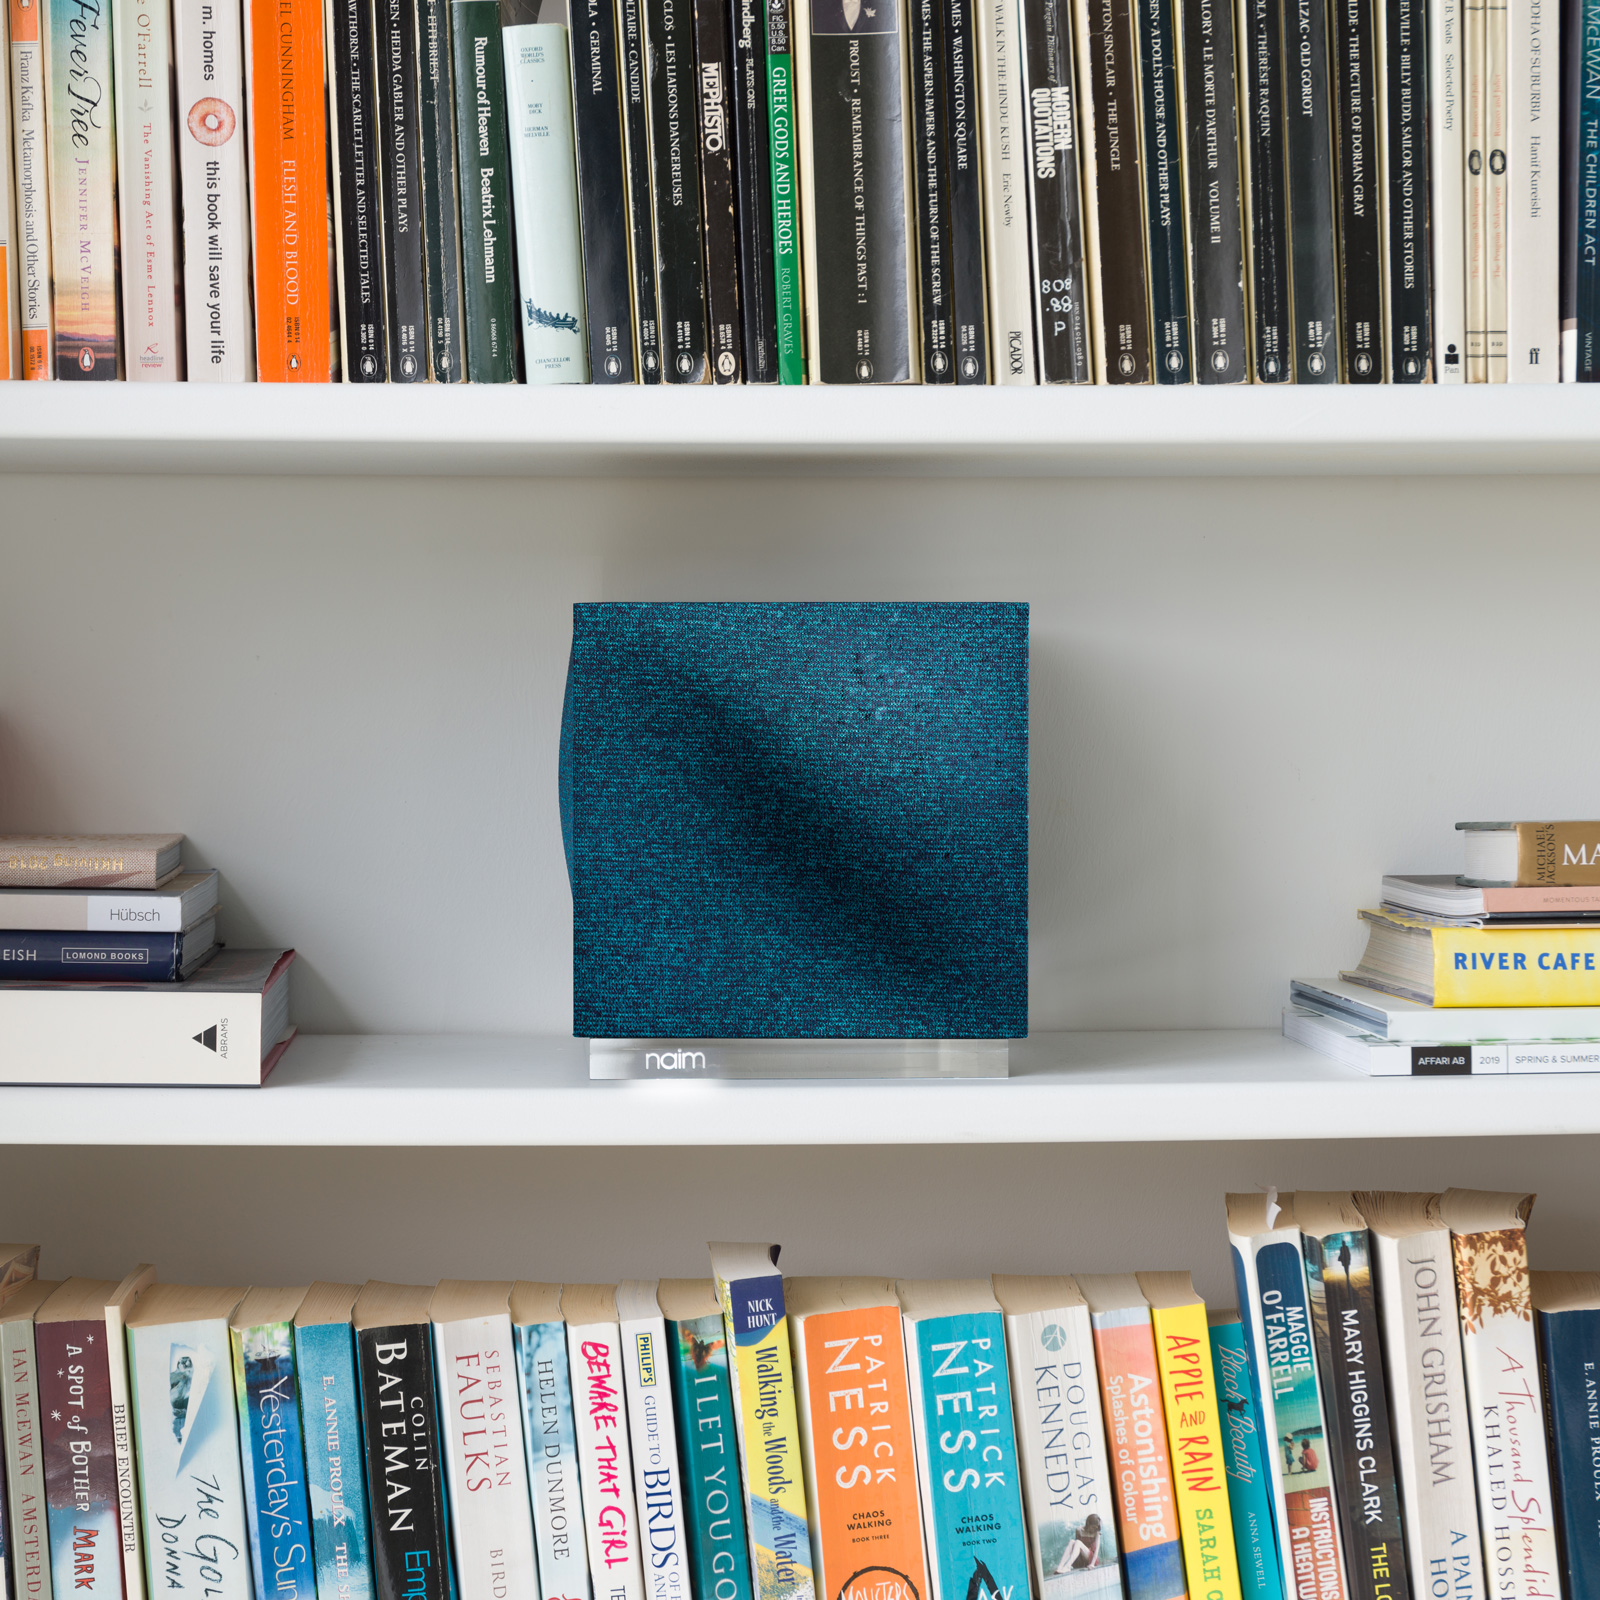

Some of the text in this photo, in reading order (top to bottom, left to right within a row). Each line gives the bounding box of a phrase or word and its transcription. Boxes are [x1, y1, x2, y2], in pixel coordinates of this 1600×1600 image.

[203, 30, 216, 81] homes
[590, 30, 602, 95] GERMINAL
[1258, 34, 1271, 136] THÉRÈSE RAQUIN
[68, 77, 101, 232] Tree JENNIFER
[701, 62, 726, 152] MEPHISTO
[1031, 88, 1055, 179] QUOTATIONS
[1051, 86, 1072, 150] MODERN
[1530, 38, 1541, 218] OF SUBURBIA Hanif Kureishi
[18, 51, 40, 319] Franz Kafka Metamorphosis and Other Stories
[136, 13, 156, 327] O'Farrell The Vanishing Act of Esme Lennox
[206, 161, 220, 189] this
[280, 22, 299, 305] CUNNINGHAM FLESH AND BLOOD
[474, 37, 498, 283] Rumour of Heaven Beatrix Lehmann
[849, 40, 867, 290] PROUST REMEMBRANCE OF THINGS PAST
[207, 193, 222, 230] book
[209, 235, 222, 260] will
[773, 67, 793, 355] GREEK GODS AND HEROES ROBERT GRAVES
[1585, 120, 1598, 372] THE CHILDREN ACT VINTAGE
[207, 303, 222, 336] your
[209, 265, 222, 298] save
[1042, 279, 1072, 294] 808
[211, 340, 225, 364] life
[1009, 331, 1023, 375] PICADOR
[1444, 366, 1460, 374] Pan
[1536, 827, 1546, 881] MICHAEL
[1543, 896, 1590, 904] MOMENTOUS
[1546, 824, 1556, 884] JACKSON'S
[3, 950, 144, 961] EISH LOMOND BOOKS
[110, 908, 160, 921] Hübsch
[1454, 953, 1595, 970] RIVER CAFE
[220, 1018, 229, 1058] ABRAMS
[646, 1048, 706, 1070] naim
[1418, 1056, 1450, 1065] AFFARI
[1452, 1056, 1466, 1065] AB
[1480, 1056, 1500, 1065] 2019
[1515, 1056, 1550, 1064] SPRING
[1560, 1054, 1600, 1063] SUMMER
[747, 1301, 772, 1311] NICK
[747, 1315, 778, 1328] HUNT
[1262, 1290, 1294, 1400] O'FARRELL
[1285, 1306, 1311, 1373] MAGGIE
[12, 1349, 28, 1383] IAN
[639, 1336, 654, 1384] PHILIP'S
[1407, 1255, 1456, 1487] JOHN GRISHAM
[1497, 1347, 1524, 1373] A
[259, 1375, 302, 1539] Yesterday's
[377, 1339, 414, 1532] BATEMAN
[410, 1396, 429, 1471] COLIN
[455, 1353, 492, 1493] FAULKS
[484, 1350, 512, 1488] SEBASTIAN
[581, 1341, 620, 1498] BEWARE THAT
[644, 1396, 661, 1464] GUIDE TO
[695, 1392, 723, 1454] LET
[824, 1337, 871, 1489] NESS
[862, 1334, 896, 1485] PATRICK
[932, 1340, 980, 1493] NESS
[971, 1339, 1005, 1489] PATRICK
[1035, 1365, 1073, 1510] KENNEDY
[1063, 1361, 1098, 1507] DOUGLAS
[1108, 1375, 1138, 1524] Splashes of Colour
[1127, 1373, 1167, 1540] Astonishing
[1341, 1309, 1389, 1580] MARY HIGGINS CLARK THE
[1498, 1379, 1536, 1483] Thousand
[66, 1344, 99, 1590] A SPOT of BOTHER MARK
[114, 1404, 135, 1553] BRIEF ENCOUNTER
[539, 1360, 569, 1560] HELEN DUNMORE
[703, 1466, 731, 1540] YOU
[753, 1346, 797, 1586] Walking the Woods and the Water
[1166, 1335, 1223, 1582] APPLE AND RAIN SARAH
[1218, 1345, 1266, 1590] Black Beauty ANNA SEWELL
[1483, 1405, 1507, 1511] KHALED
[155, 1513, 186, 1589] DONNA
[643, 1467, 679, 1569] BIRDS
[955, 1523, 1002, 1534] WALKING
[961, 1514, 994, 1524] CHAOS
[1507, 1489, 1555, 1599] Splendid
